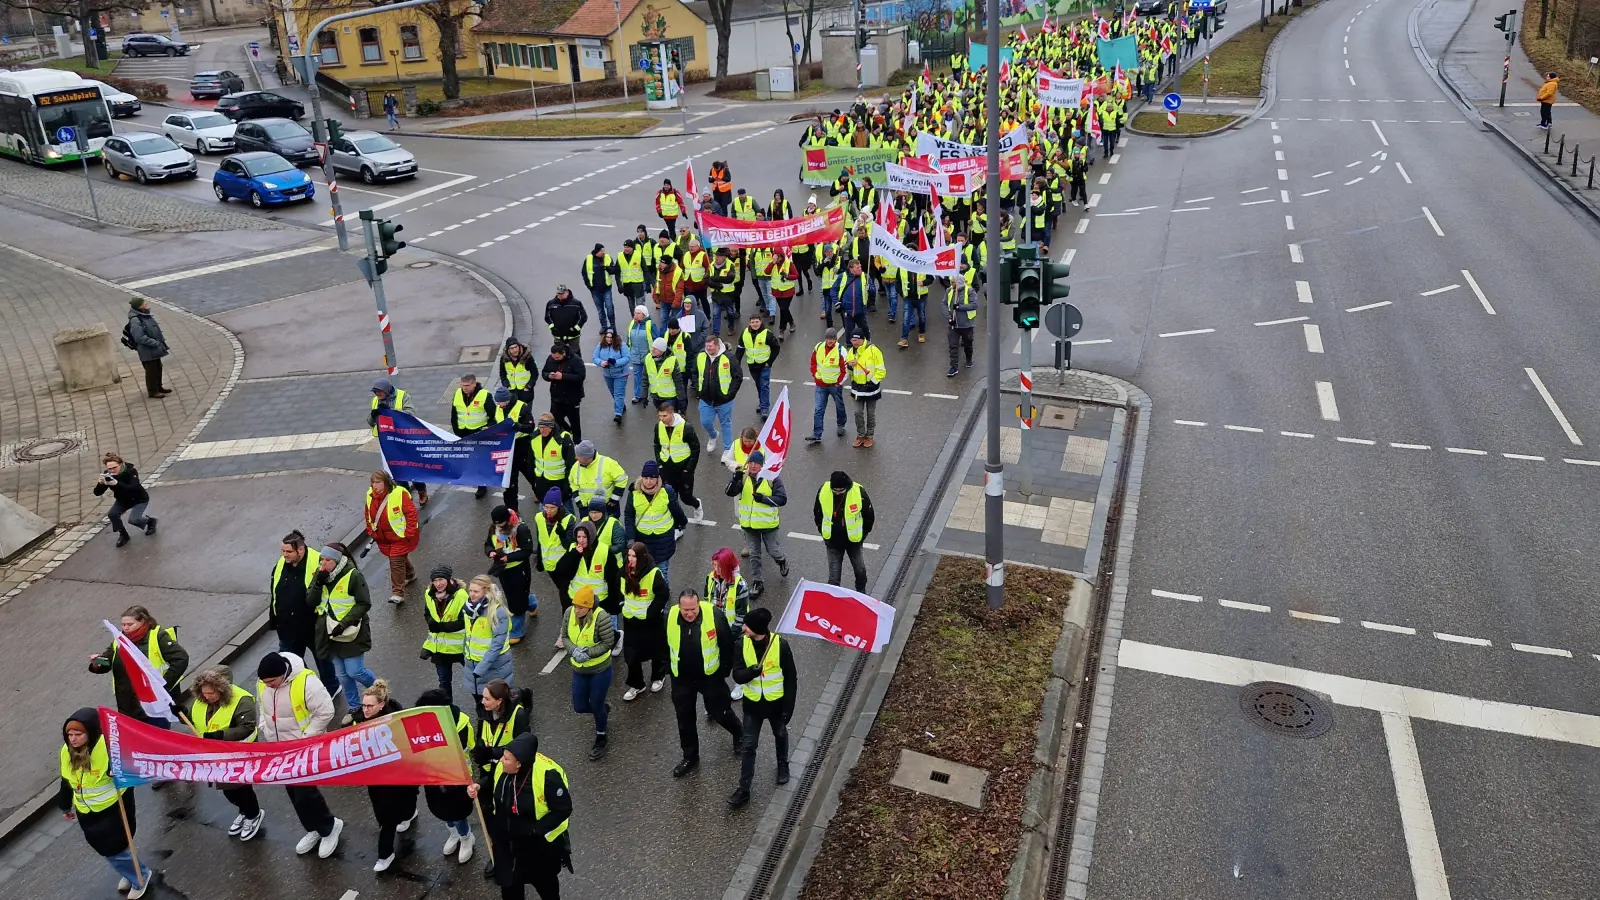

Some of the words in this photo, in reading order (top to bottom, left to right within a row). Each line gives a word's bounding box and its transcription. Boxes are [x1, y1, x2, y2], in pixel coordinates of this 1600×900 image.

[828, 157, 848, 166] unter
[850, 153, 892, 164] Spannung
[889, 174, 904, 183] Wir
[710, 229, 763, 243] ZUSAMMEN
[767, 225, 794, 240] GEHT
[797, 216, 825, 233] MEHR
[875, 237, 890, 251] Wir
[891, 248, 927, 266] streiken
[133, 759, 261, 784] ZUSAMMEN
[260, 741, 324, 782] GEHT
[330, 723, 399, 769] MEHR
